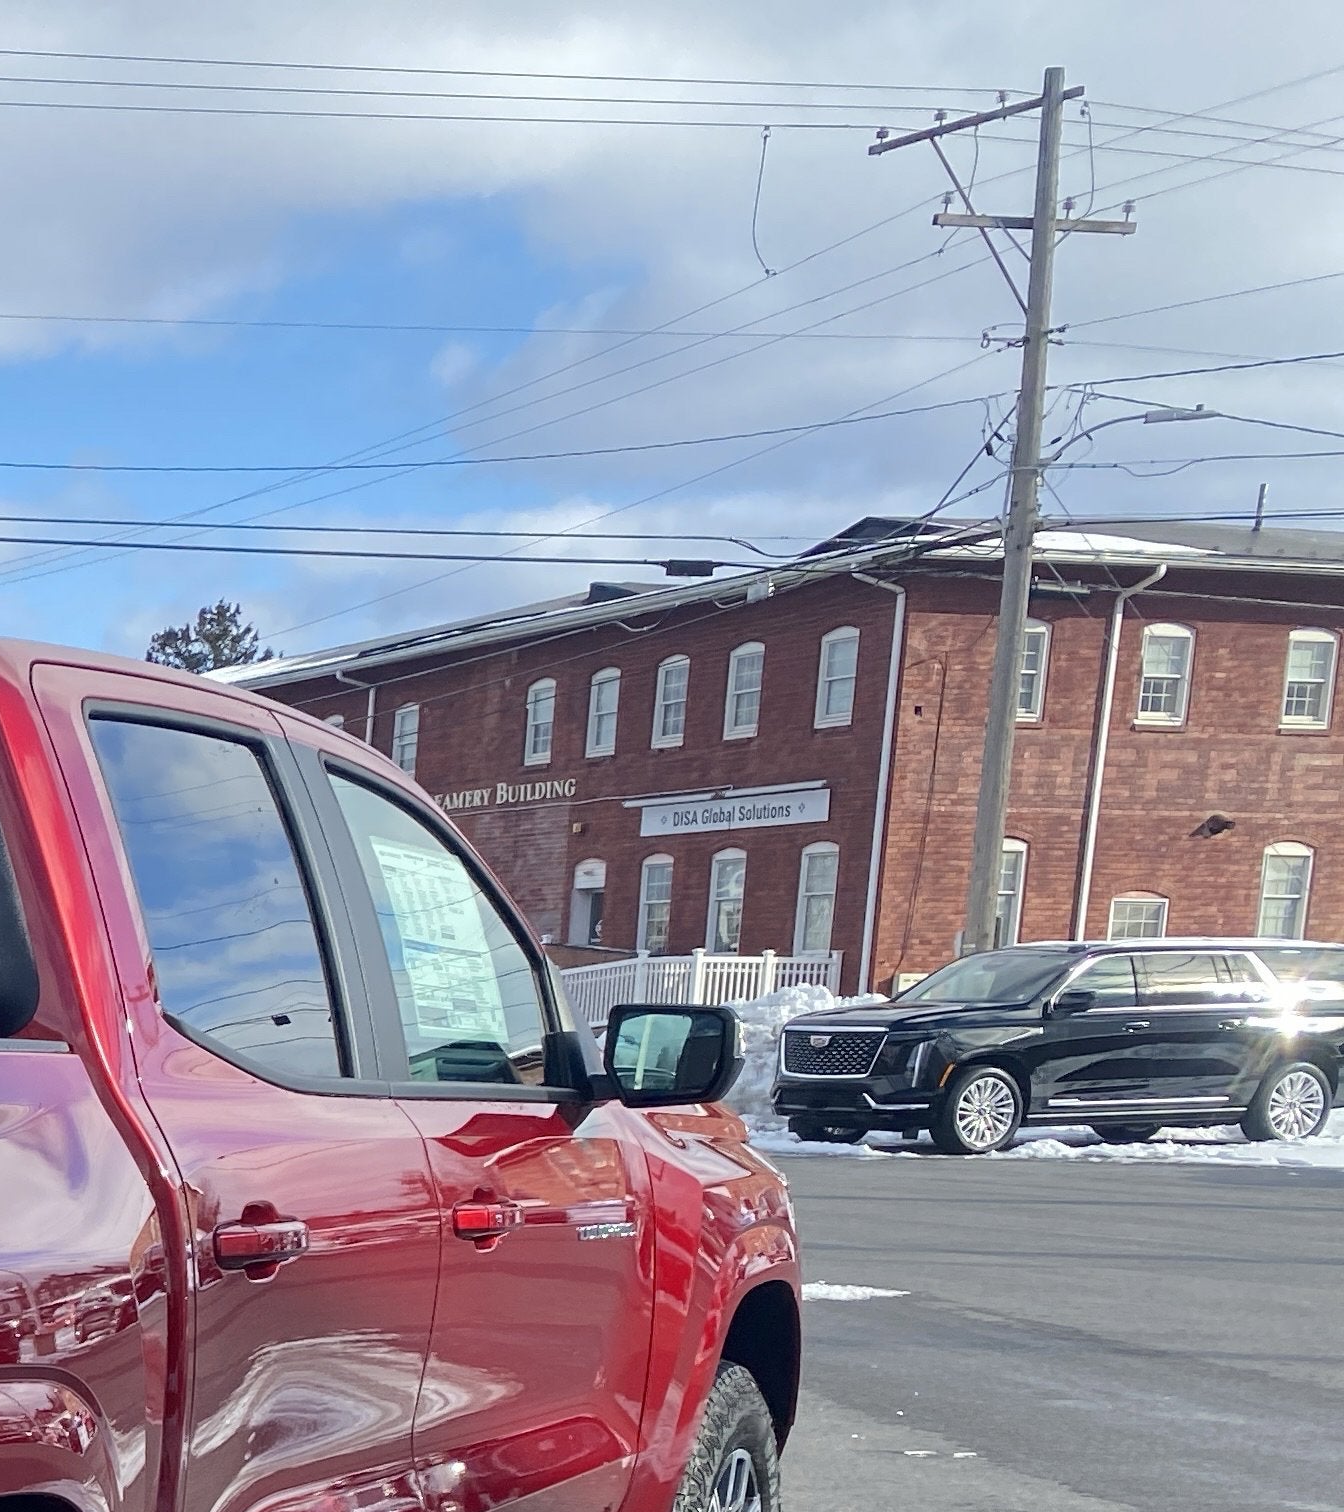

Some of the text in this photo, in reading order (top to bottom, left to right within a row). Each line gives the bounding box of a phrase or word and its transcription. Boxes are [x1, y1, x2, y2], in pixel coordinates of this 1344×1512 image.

[673, 803, 792, 827] DISA Global Solutions
